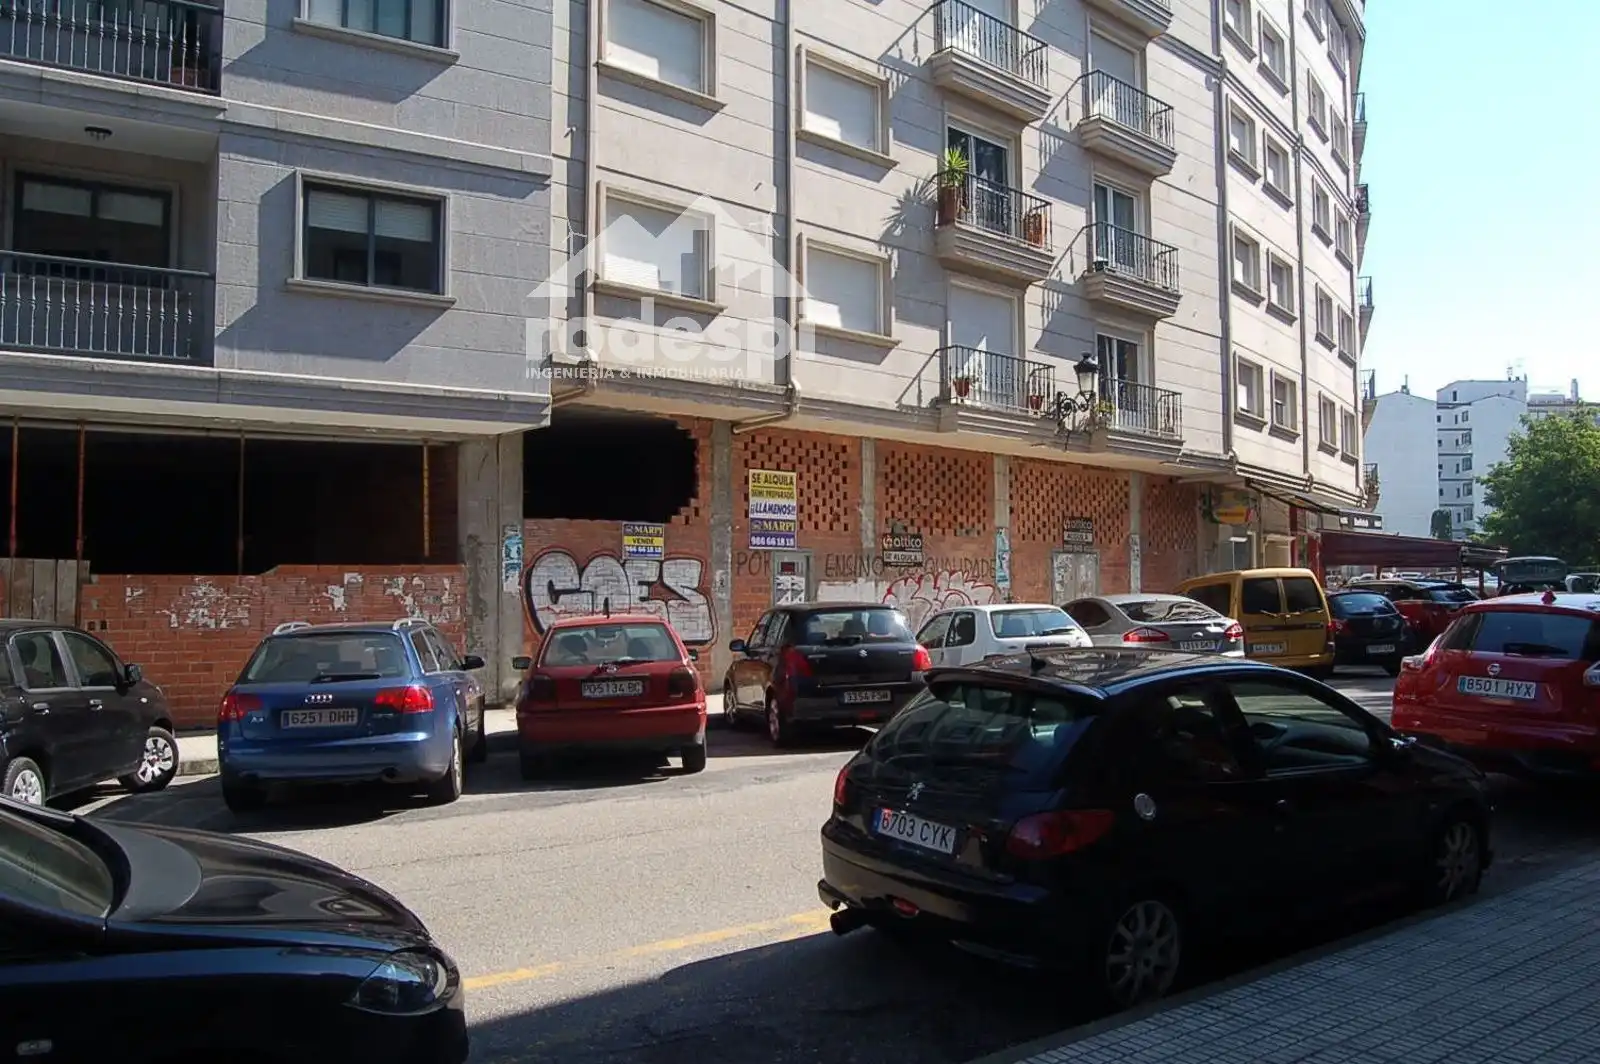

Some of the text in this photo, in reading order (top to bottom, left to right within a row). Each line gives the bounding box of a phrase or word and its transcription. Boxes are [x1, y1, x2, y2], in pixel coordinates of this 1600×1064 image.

[751, 473, 794, 486] SE ALQUILA
[634, 525, 663, 534] MARPI
[762, 521, 795, 531] MARPI
[632, 537, 655, 545] VENDE
[1466, 678, 1531, 697] 8501 HYX
[291, 711, 322, 724] 6251
[881, 812, 951, 850] 6703 CYK
